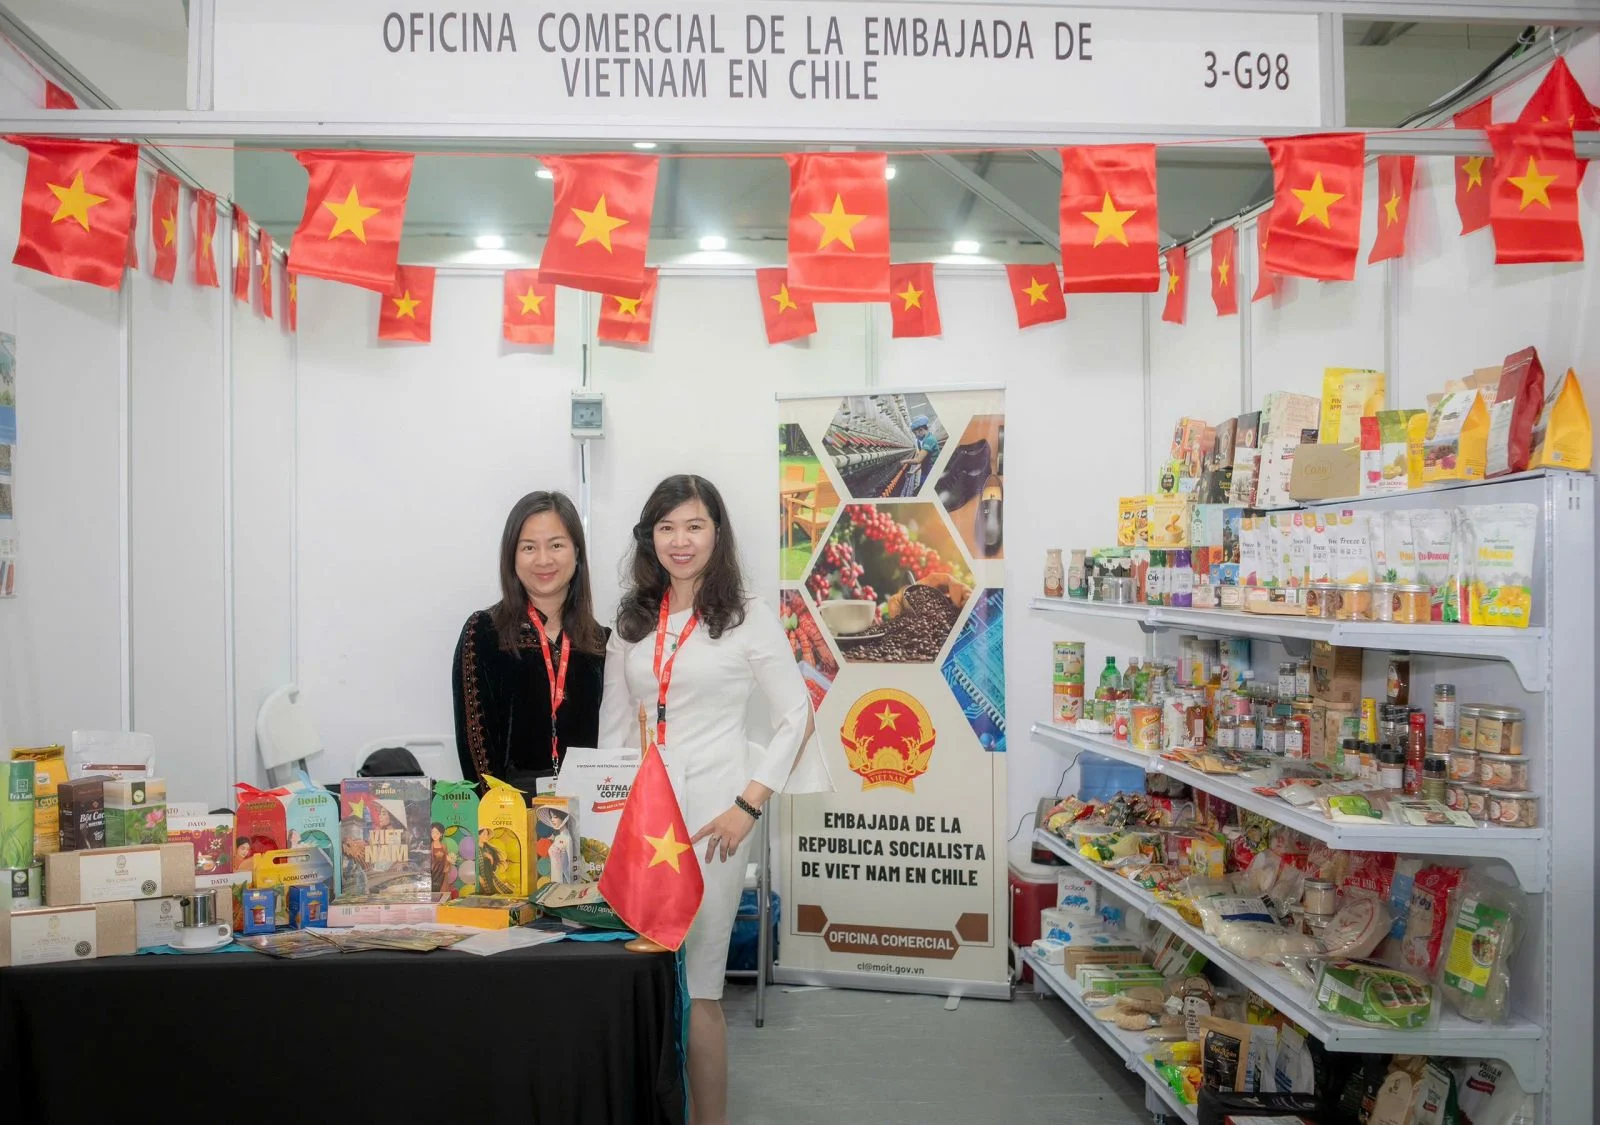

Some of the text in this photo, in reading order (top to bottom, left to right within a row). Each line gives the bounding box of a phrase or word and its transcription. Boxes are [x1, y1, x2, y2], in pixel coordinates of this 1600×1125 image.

[383, 12, 1093, 60] OFICINA COMERCIAL DE LA EMBAJADA DE
[561, 58, 877, 99] VIETNAM EN CHILE
[1204, 51, 1290, 90] 3-G98
[442, 791, 471, 801] nonla
[596, 784, 632, 792] VIETNA
[824, 812, 962, 834] EMBAJADA DE LA
[799, 836, 986, 861] REPUBLICA SOCIALISTA
[801, 861, 978, 887] DE VIET NAM EN CHILE
[829, 930, 955, 950] OFICINA COMERCIAL
[856, 962, 925, 975] cl@moit.gov.vn
